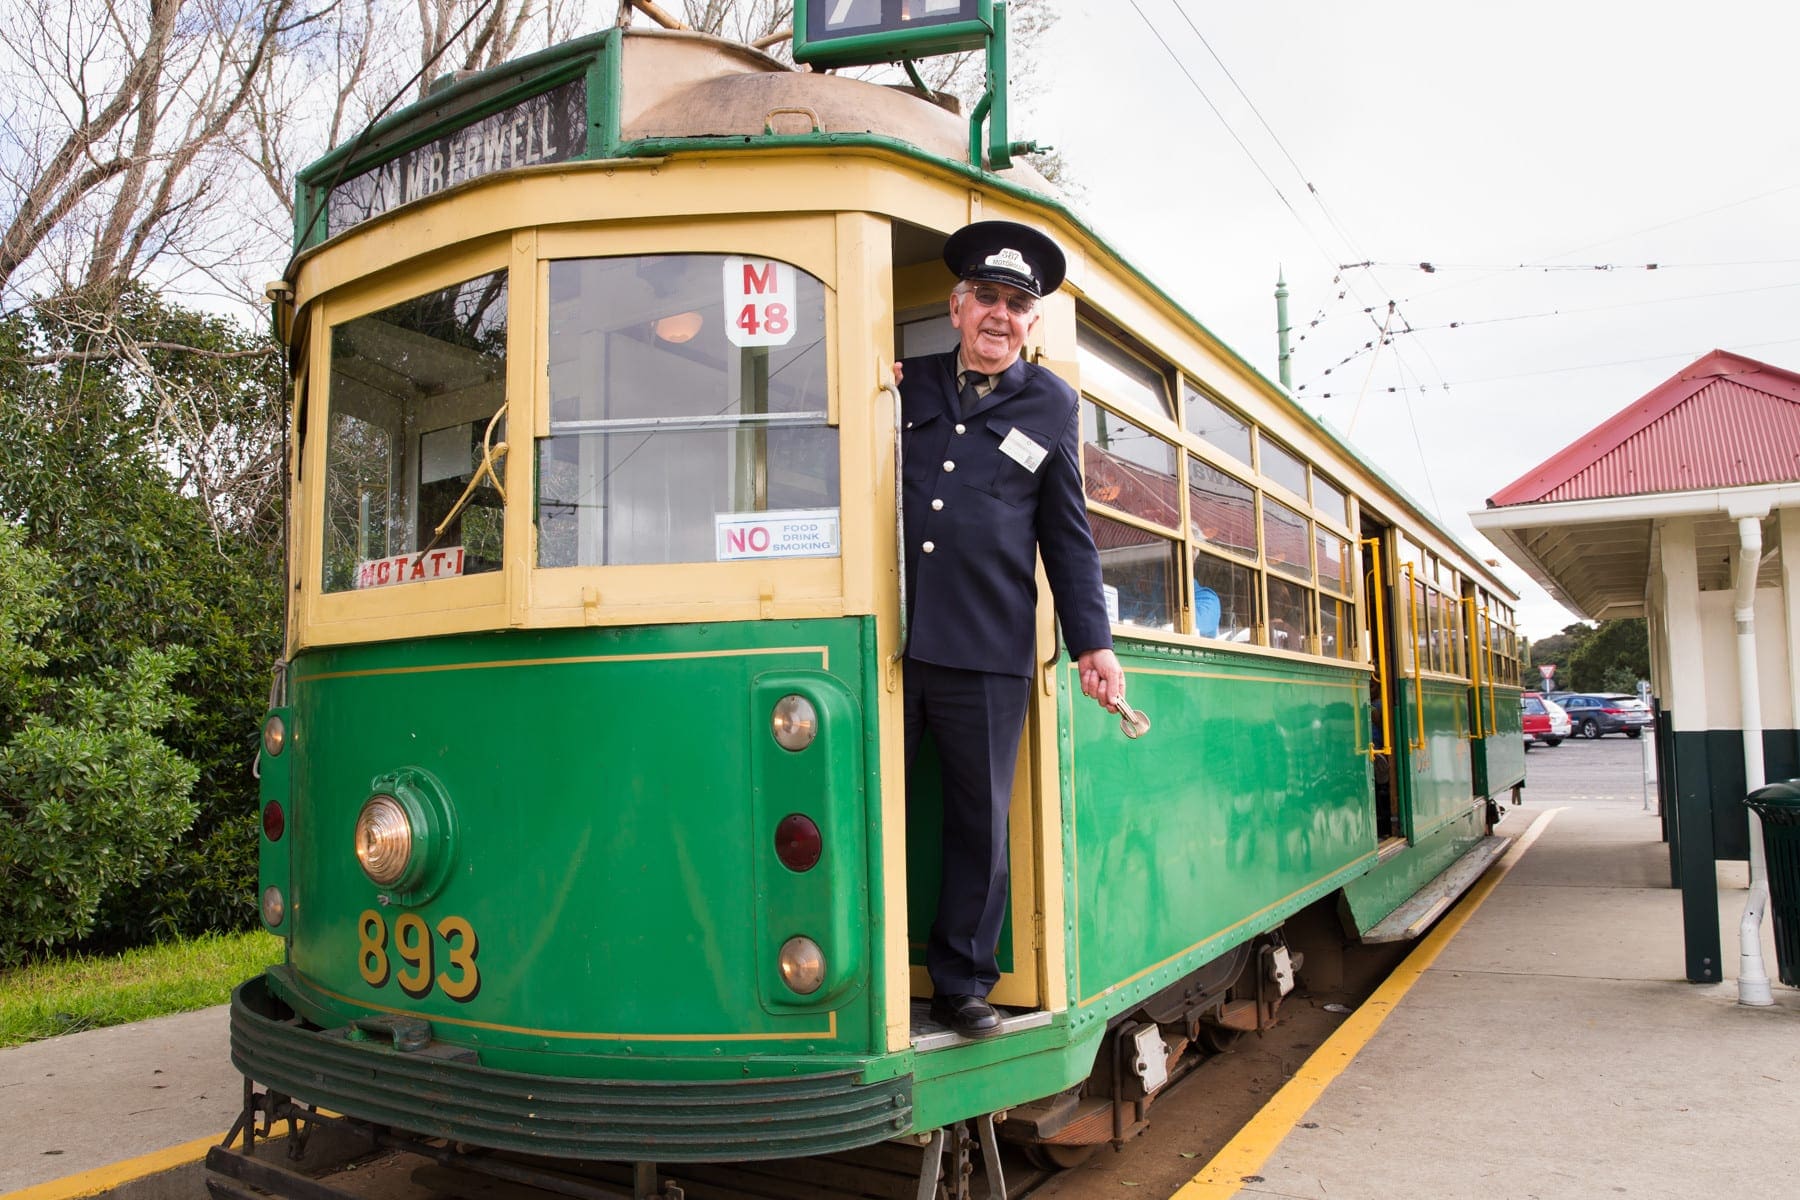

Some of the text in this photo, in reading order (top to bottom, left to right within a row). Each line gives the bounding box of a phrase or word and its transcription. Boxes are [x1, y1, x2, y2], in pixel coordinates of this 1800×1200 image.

[743, 262, 778, 295] M
[736, 302, 789, 335] 48
[726, 526, 771, 553] NO
[783, 524, 818, 532] FOOD
[783, 532, 820, 542] DRINK
[772, 541, 831, 552] SMOKING
[358, 908, 482, 1004] 893
